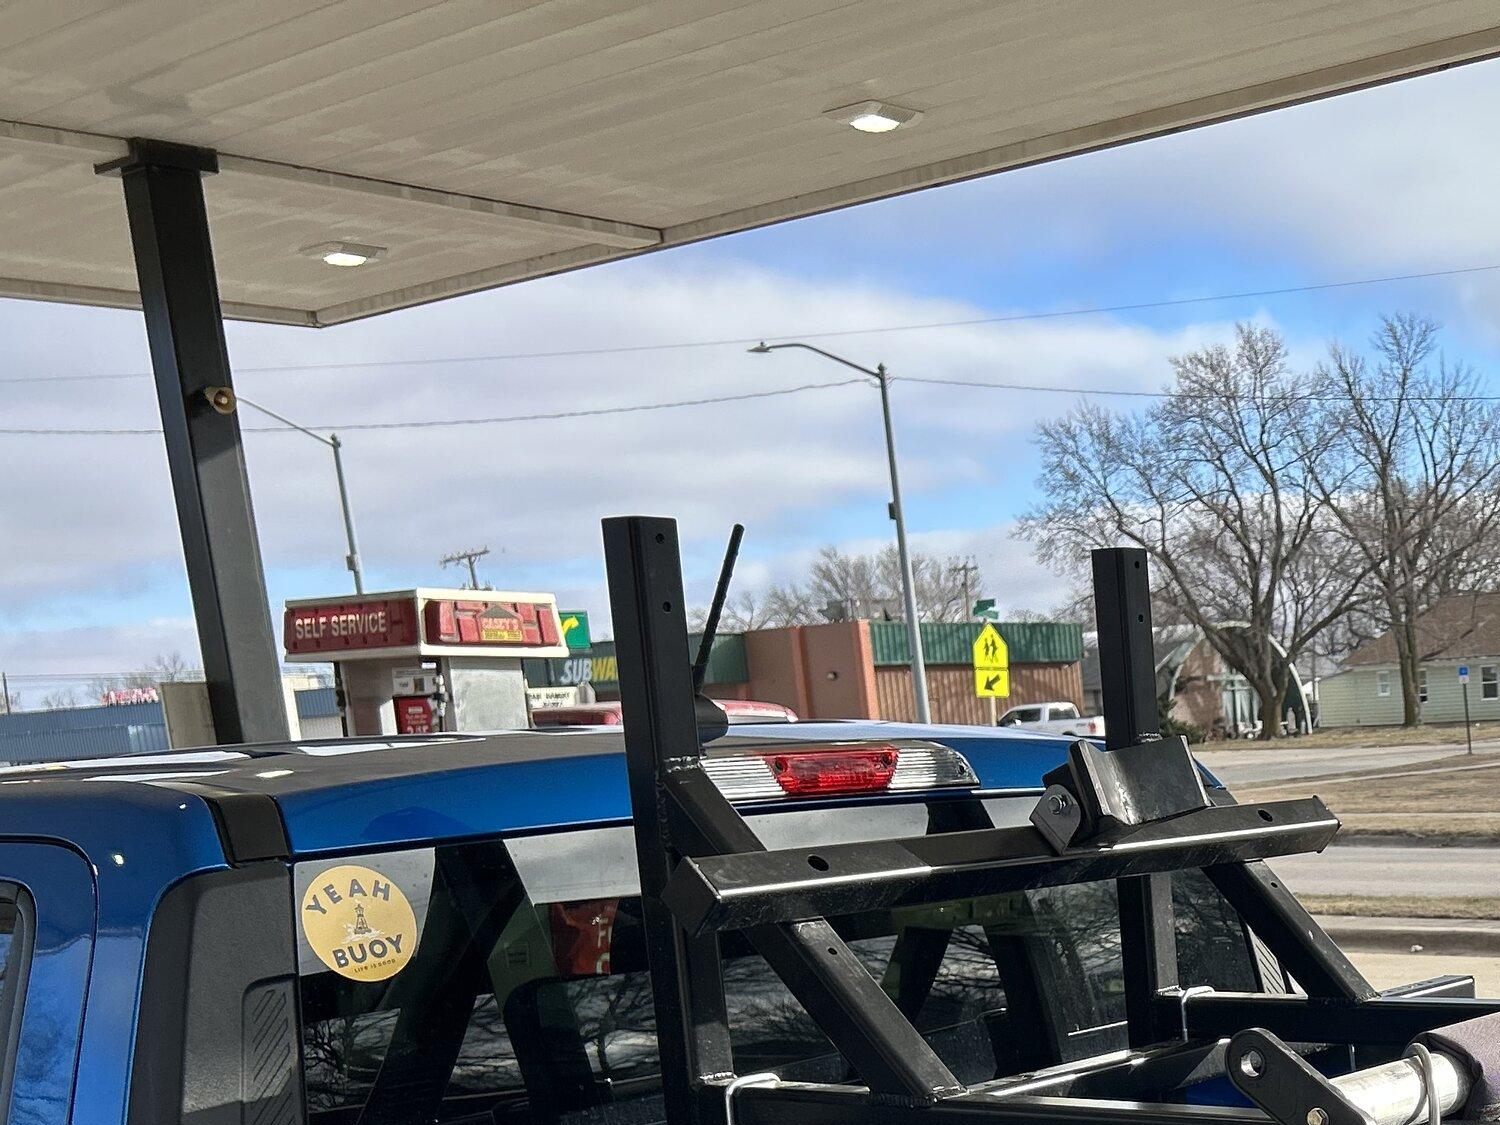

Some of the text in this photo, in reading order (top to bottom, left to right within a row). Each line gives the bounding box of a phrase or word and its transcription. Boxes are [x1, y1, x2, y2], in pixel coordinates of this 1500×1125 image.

[295, 611, 387, 640] SELF SERVICE
[560, 657, 617, 684] SUBWA
[305, 878, 391, 915] YEAH
[332, 933, 403, 969] BUOY
